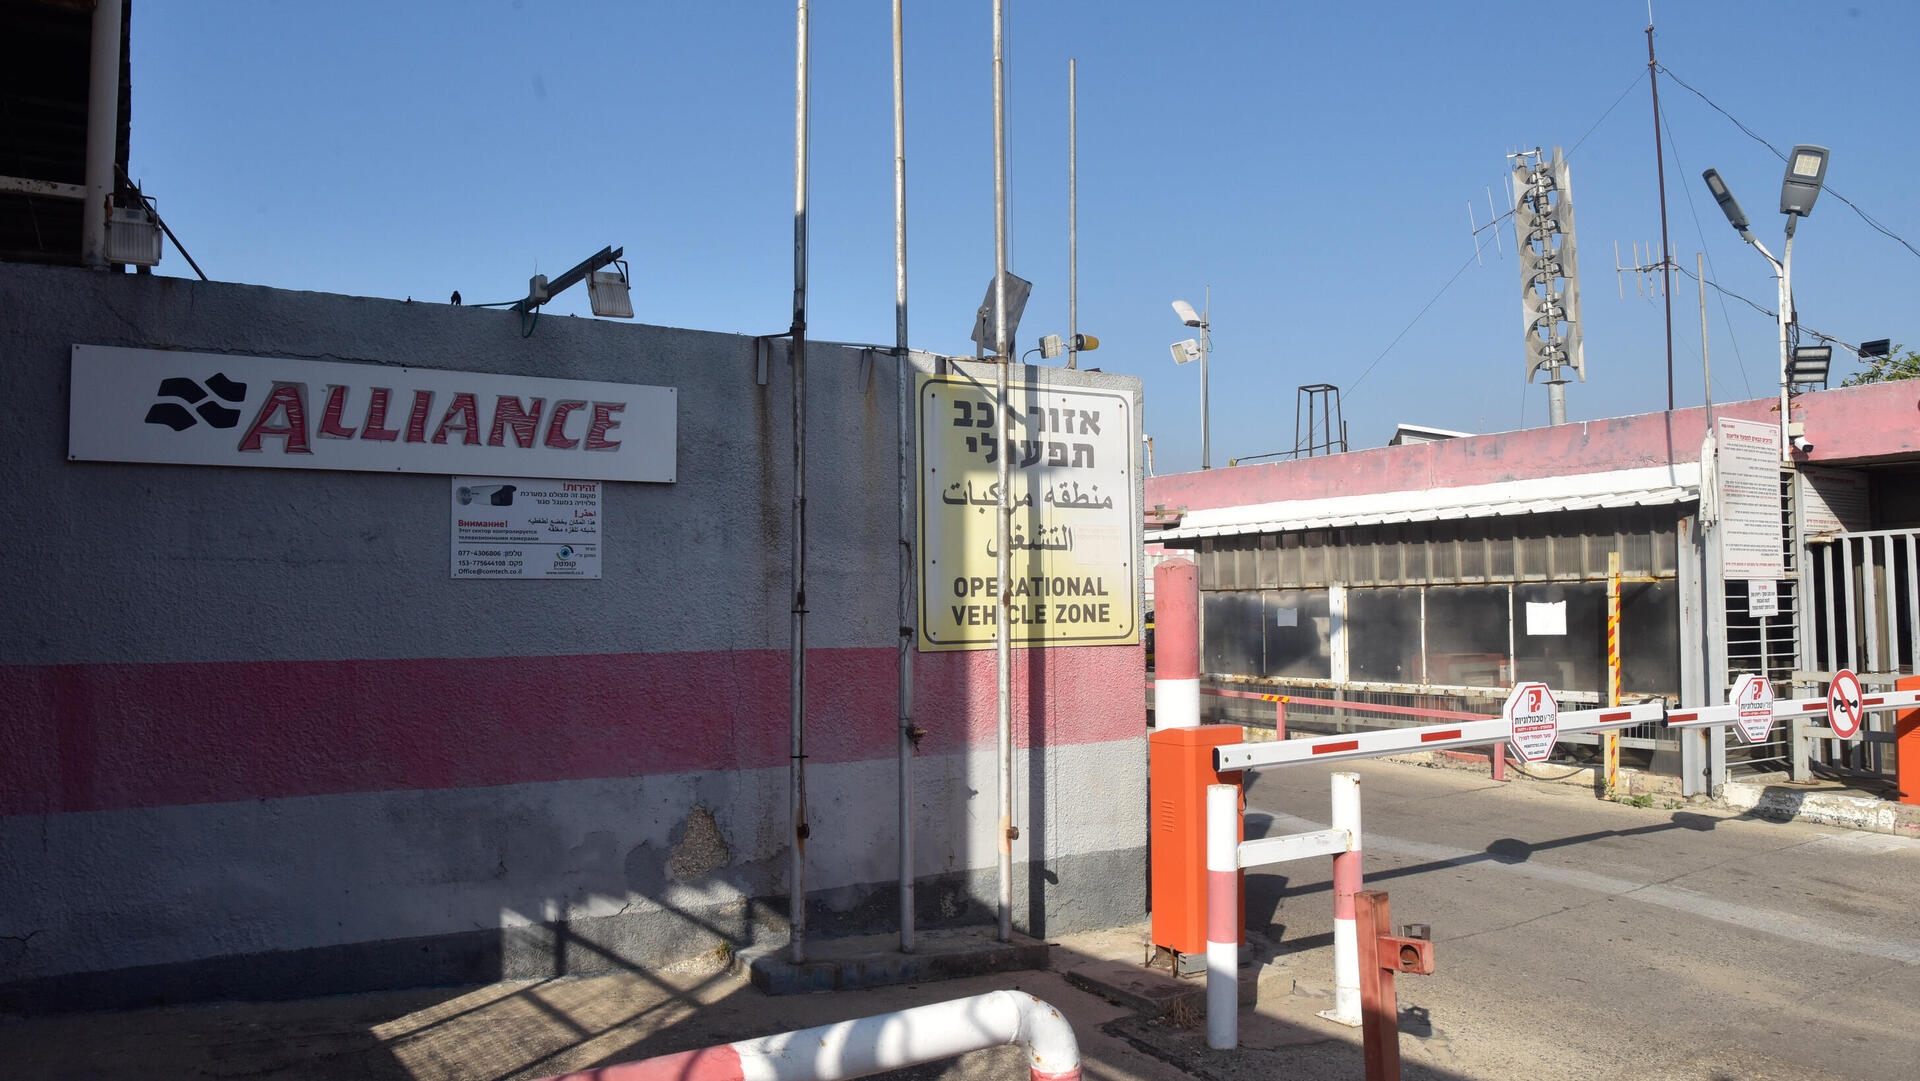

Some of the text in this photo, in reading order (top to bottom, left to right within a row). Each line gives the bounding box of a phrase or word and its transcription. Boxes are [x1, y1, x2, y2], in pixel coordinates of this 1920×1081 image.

[238, 381, 627, 455] ALLIANCE
[1029, 406, 1101, 436] אזור
[966, 433, 1095, 468] תפעולי
[563, 482, 596, 492] זהירות!
[942, 480, 1033, 515] مركبات
[458, 519, 508, 528] Внимание!
[951, 603, 1110, 626] VEHCLE ZONE
